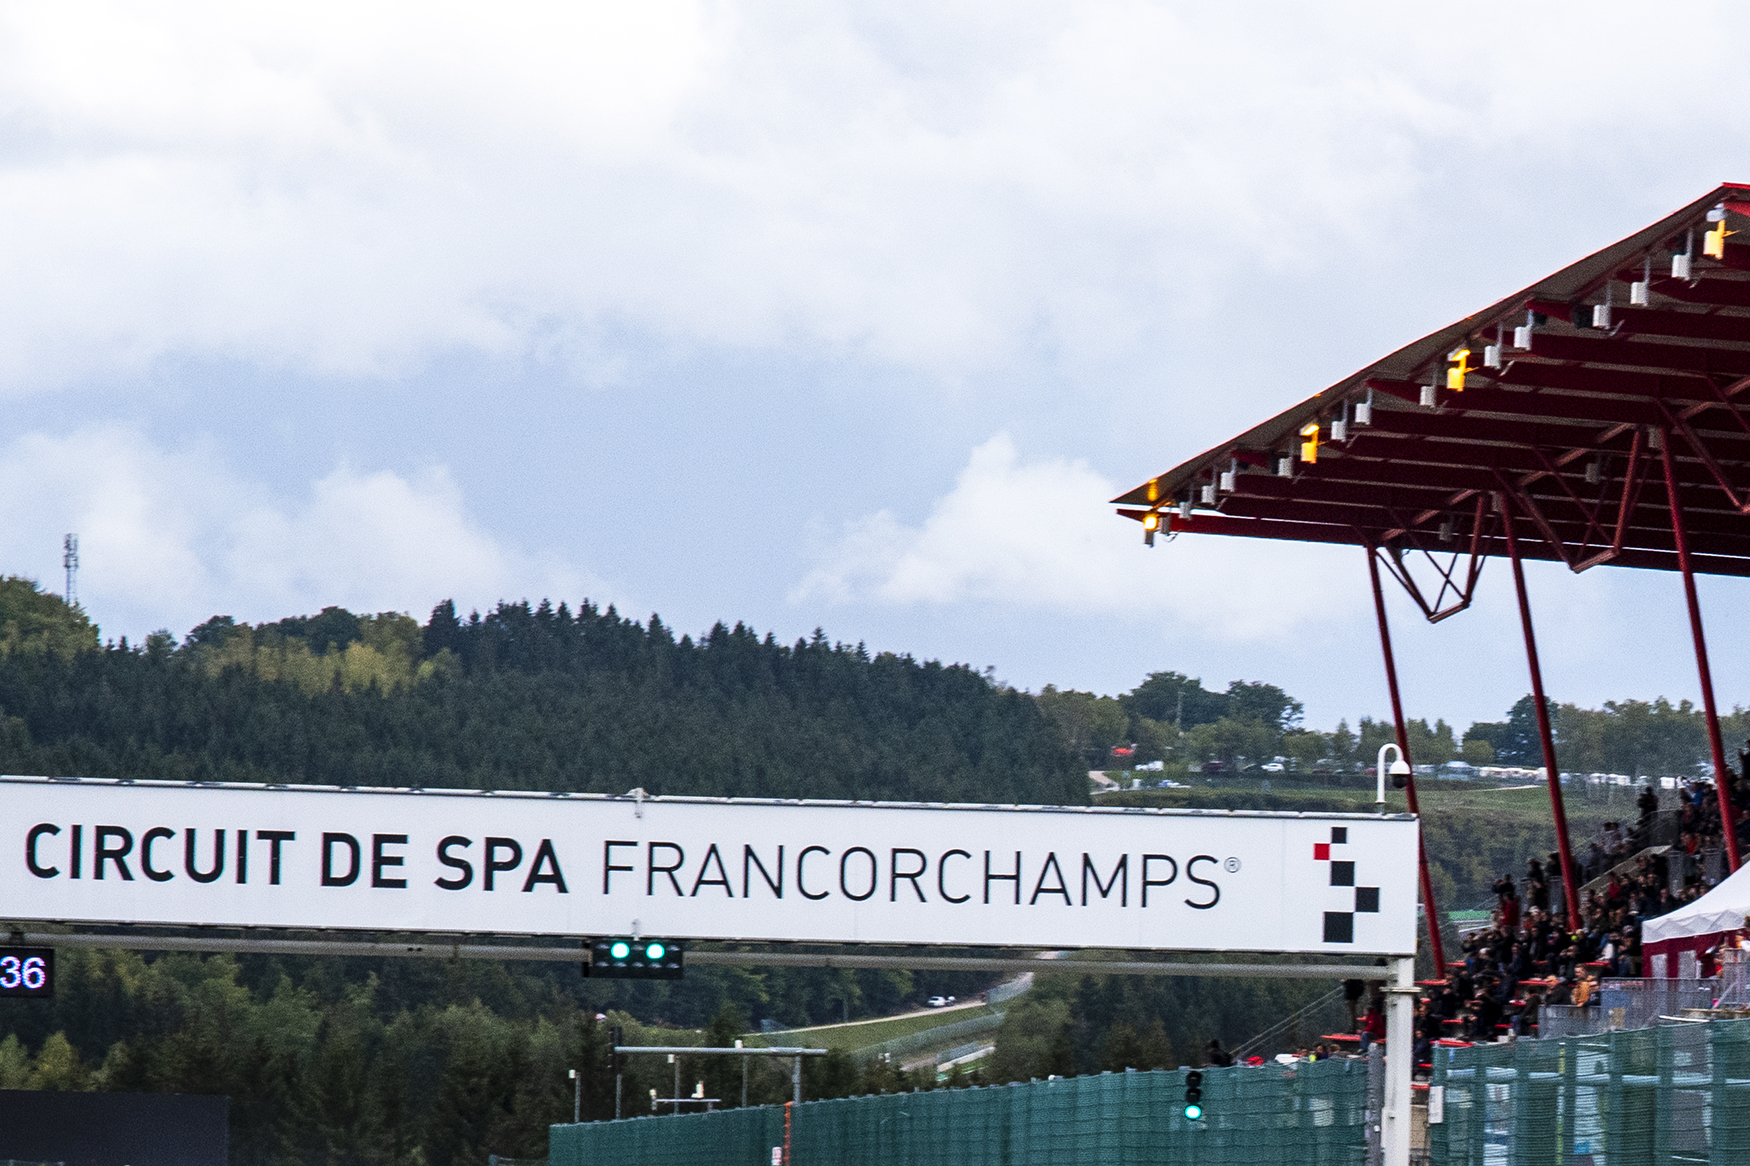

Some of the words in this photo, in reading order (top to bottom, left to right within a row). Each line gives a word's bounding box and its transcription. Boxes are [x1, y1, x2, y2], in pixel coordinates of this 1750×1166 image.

[26, 823, 295, 886] CIRCUIT
[321, 832, 408, 889] DE
[434, 835, 569, 894] SPA
[0, 956, 47, 990] 36
